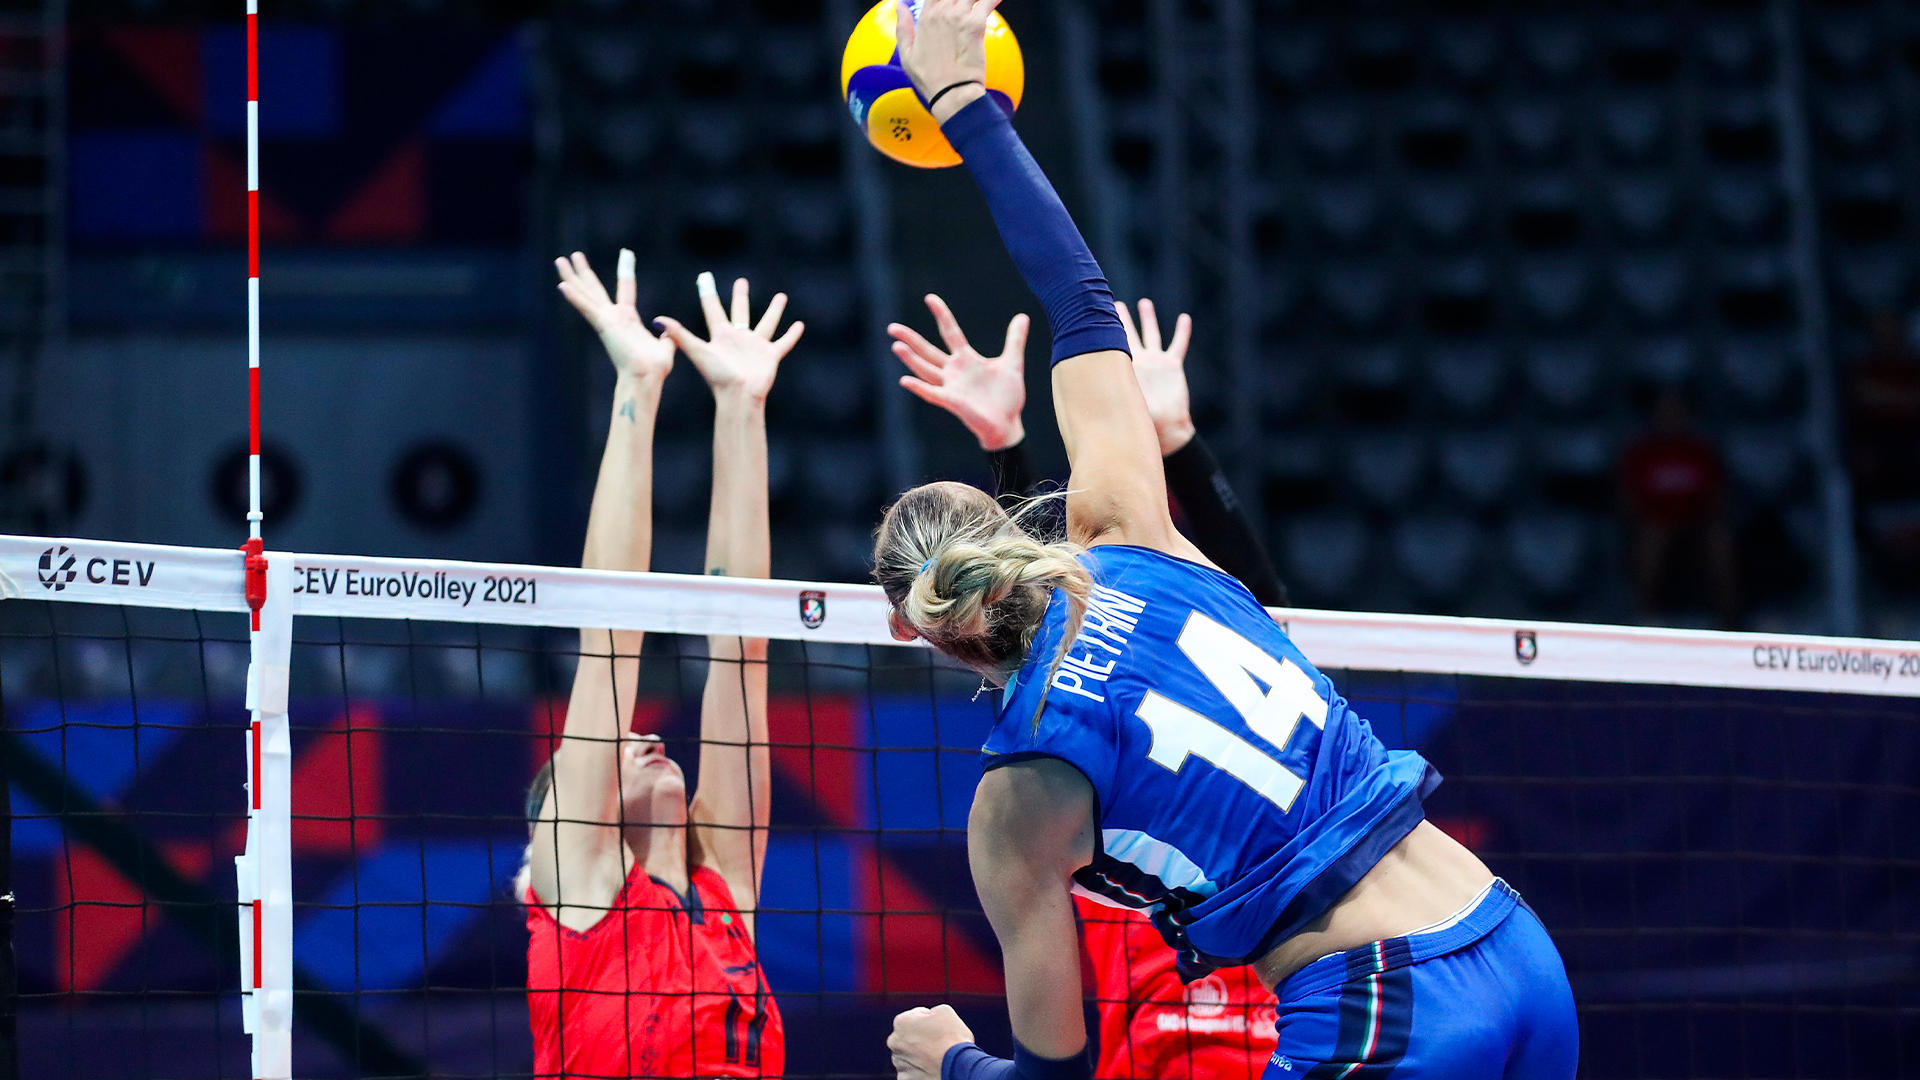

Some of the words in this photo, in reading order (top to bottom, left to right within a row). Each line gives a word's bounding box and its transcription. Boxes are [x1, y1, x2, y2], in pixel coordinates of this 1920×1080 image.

[86, 557, 155, 587] CEV
[293, 566, 339, 594] CEV
[346, 568, 477, 607] EuroVolley
[483, 575, 537, 604] 2021
[1753, 644, 1791, 669] CEV
[1797, 647, 1894, 681] EuroVolley
[1134, 609, 1329, 814] 14
